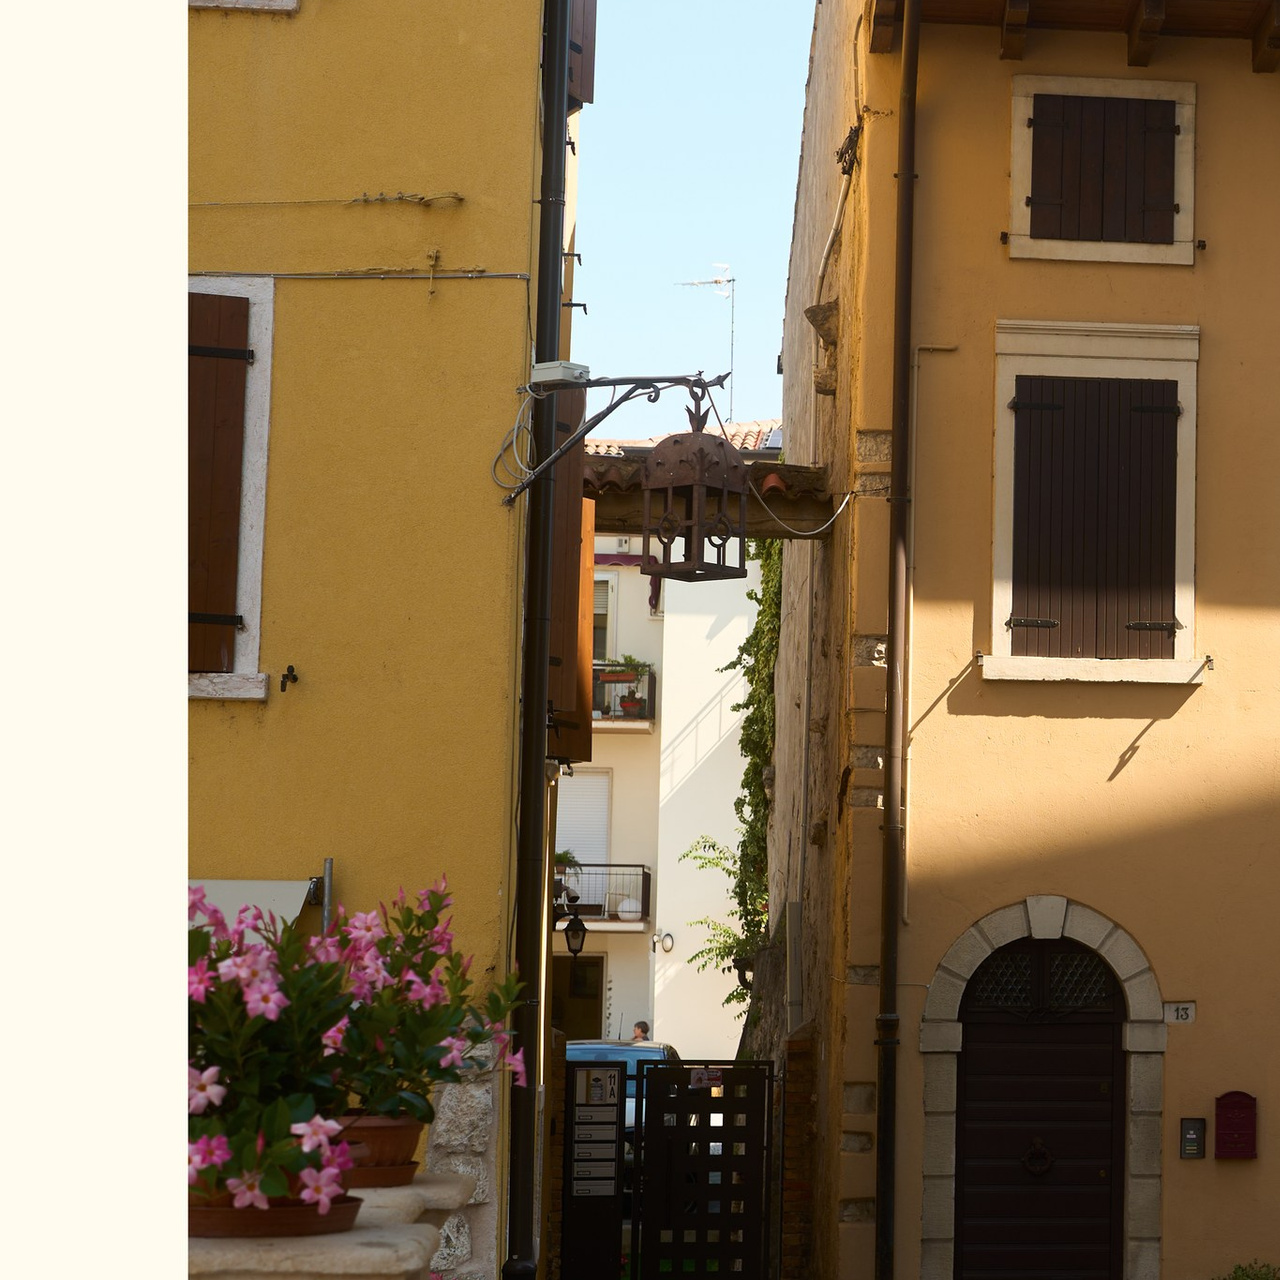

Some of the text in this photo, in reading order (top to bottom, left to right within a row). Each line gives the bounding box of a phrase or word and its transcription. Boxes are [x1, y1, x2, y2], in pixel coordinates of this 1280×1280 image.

[1174, 1006, 1190, 1021] 13
[608, 1073, 616, 1086] 11
[609, 1086, 616, 1099] A
